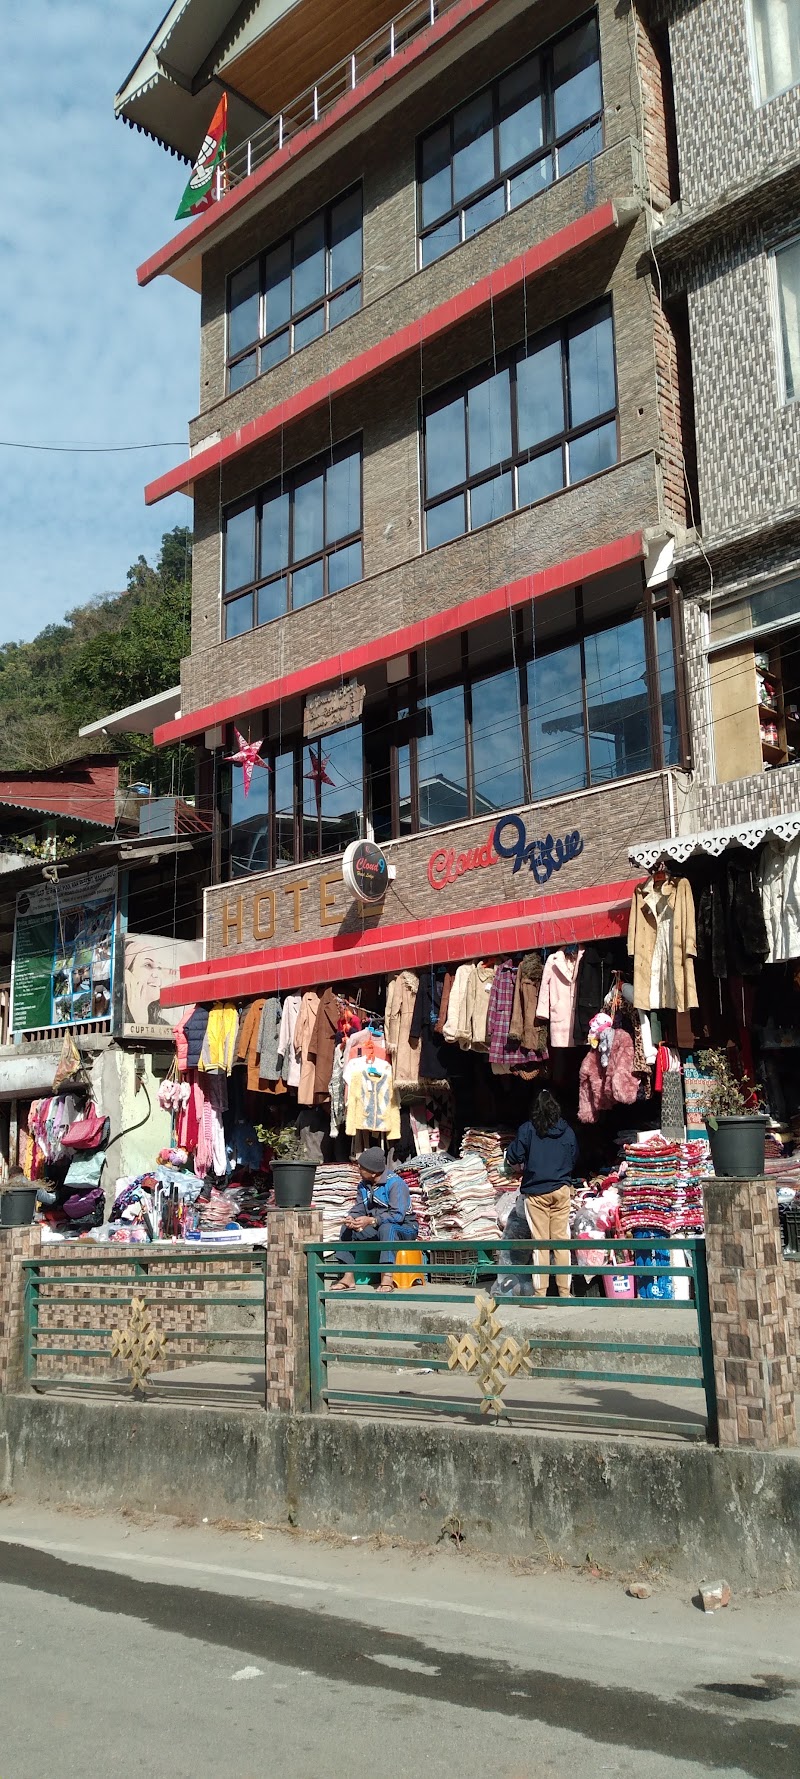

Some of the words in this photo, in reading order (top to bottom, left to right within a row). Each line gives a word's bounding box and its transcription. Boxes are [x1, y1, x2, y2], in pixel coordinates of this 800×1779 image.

[356, 858, 379, 872] Cloud
[378, 859, 385, 873] 9
[427, 826, 499, 890] Cloud
[493, 813, 526, 874] 9
